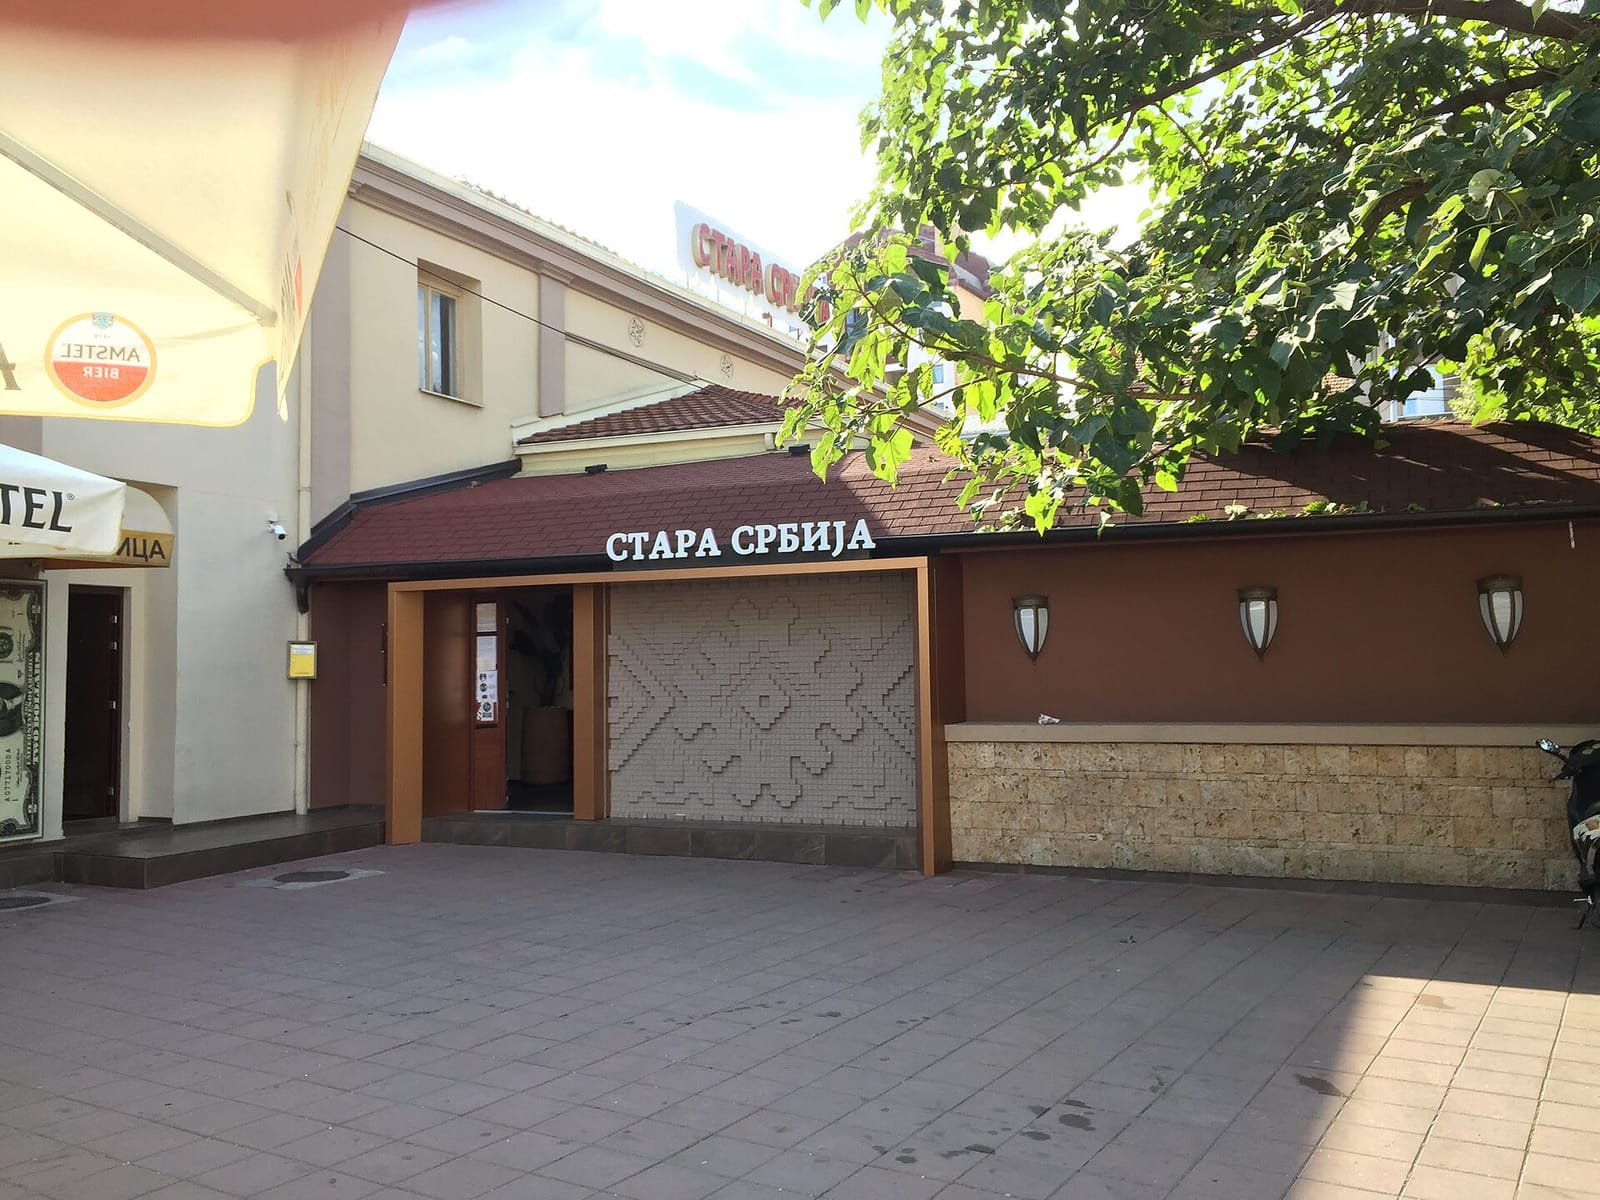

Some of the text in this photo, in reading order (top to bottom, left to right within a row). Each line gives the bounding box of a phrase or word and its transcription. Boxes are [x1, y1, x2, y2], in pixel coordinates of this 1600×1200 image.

[692, 223, 764, 295] СТАРА
[605, 518, 877, 562] СТАРА СРБИЈА
